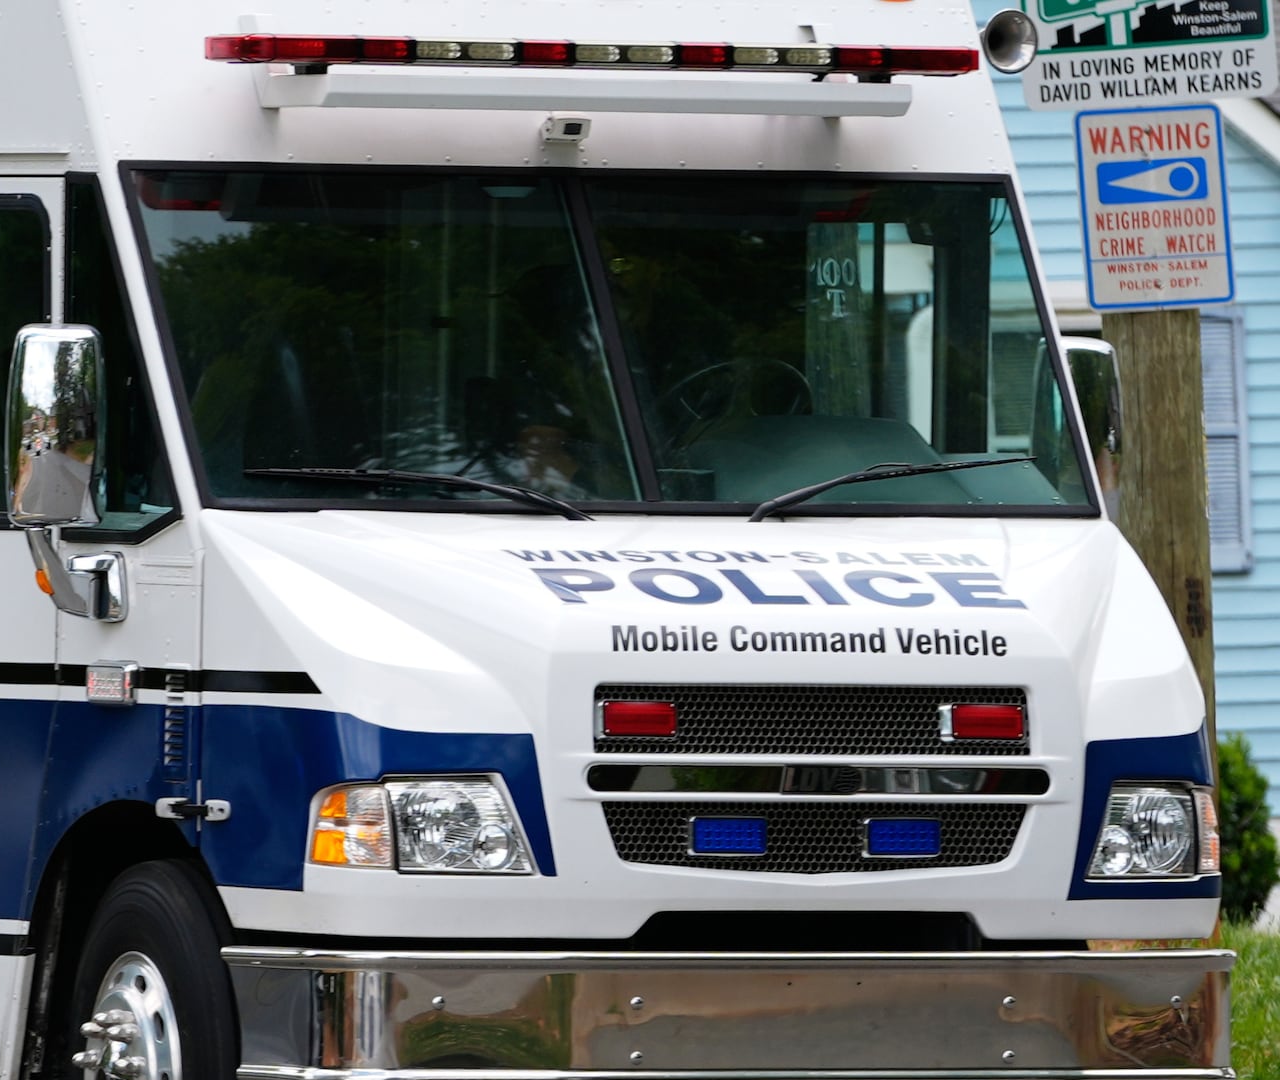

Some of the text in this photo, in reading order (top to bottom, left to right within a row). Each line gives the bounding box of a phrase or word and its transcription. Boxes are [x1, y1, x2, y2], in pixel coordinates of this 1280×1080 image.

[1172, 11, 1258, 25] Winston-Salem
[1200, 1, 1229, 13] Keep
[1191, 23, 1242, 36] Beautiful
[1042, 49, 1255, 80] IN LOVING MEMORY OF
[1040, 72, 1262, 103] DAVID WILLIAM KEARNS
[1089, 122, 1210, 155] WARNING
[1095, 208, 1216, 231] NEIGHBORHOOD
[1100, 233, 1216, 257] CRIME WATCH
[1107, 260, 1208, 274] WINSTON SALEM
[1119, 279, 1162, 291] POLICE
[502, 548, 990, 568] WINSTON-SALEM
[532, 568, 1029, 610] POLICE
[610, 624, 1009, 657] Mobile Command Vehicle
